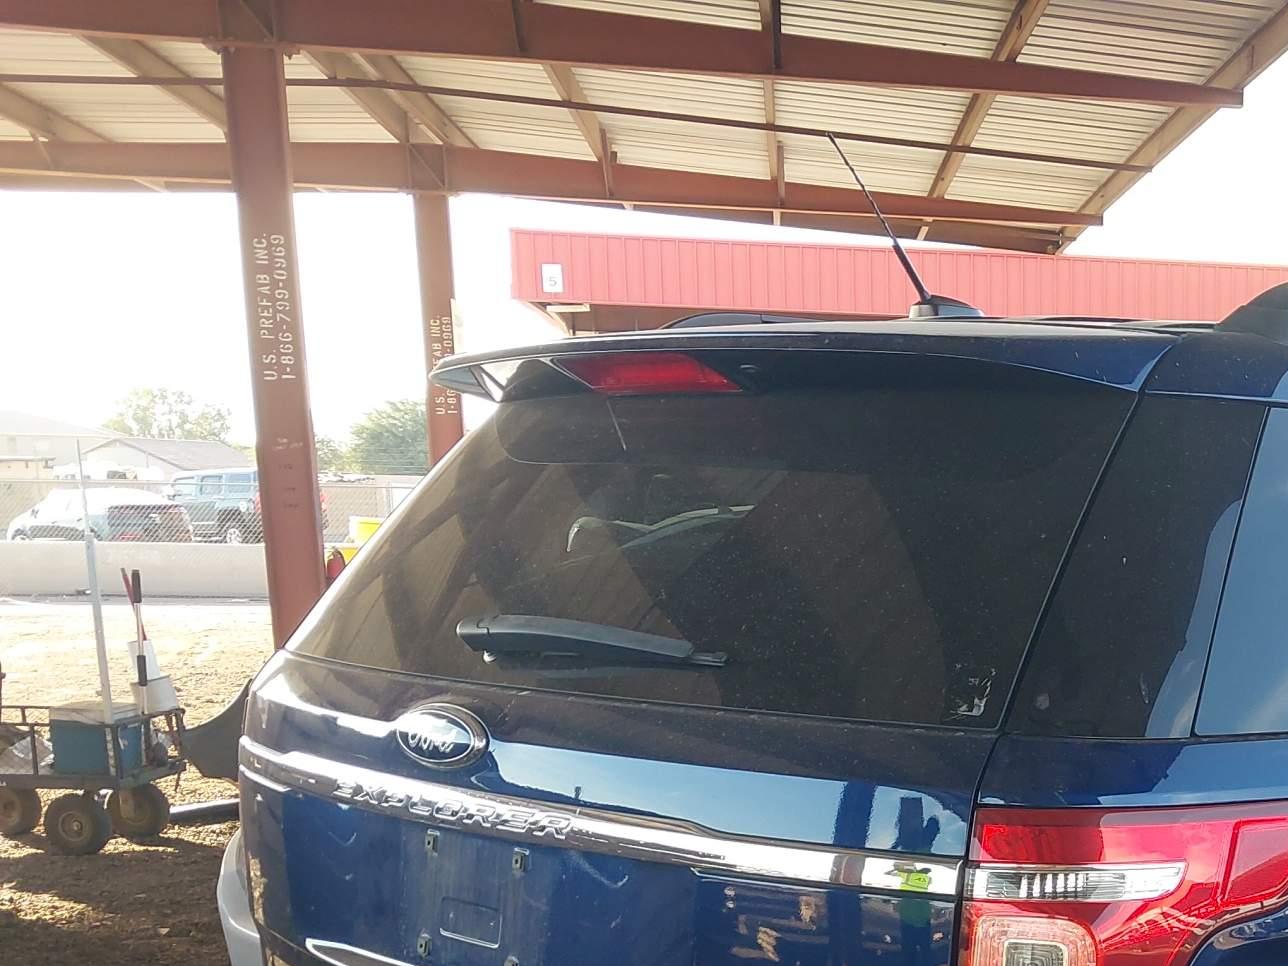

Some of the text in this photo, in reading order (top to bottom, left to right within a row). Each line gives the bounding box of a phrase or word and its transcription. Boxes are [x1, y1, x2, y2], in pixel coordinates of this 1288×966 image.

[253, 233, 278, 381] U.S. PREFAB INC.
[332, 778, 573, 839] EXPLORER
